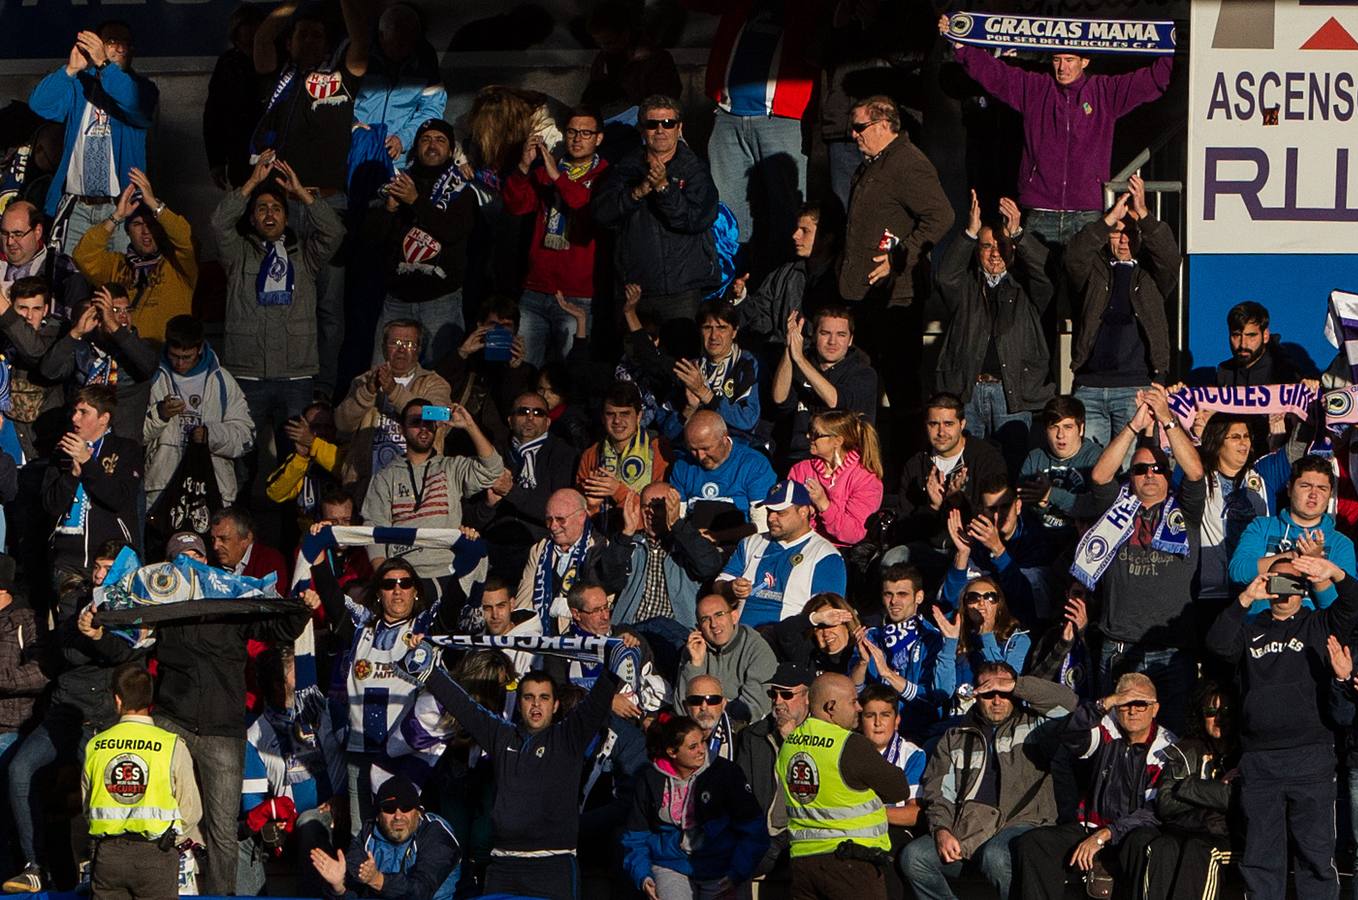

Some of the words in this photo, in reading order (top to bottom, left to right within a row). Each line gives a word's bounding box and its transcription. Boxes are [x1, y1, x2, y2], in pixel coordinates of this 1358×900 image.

[984, 15, 1083, 38] GRACIAS
[1087, 22, 1160, 41] MAMA
[986, 34, 1014, 43] POR
[1016, 36, 1037, 44] SER
[1039, 37, 1061, 45] DEL
[94, 738, 162, 752] SEGURIDAD
